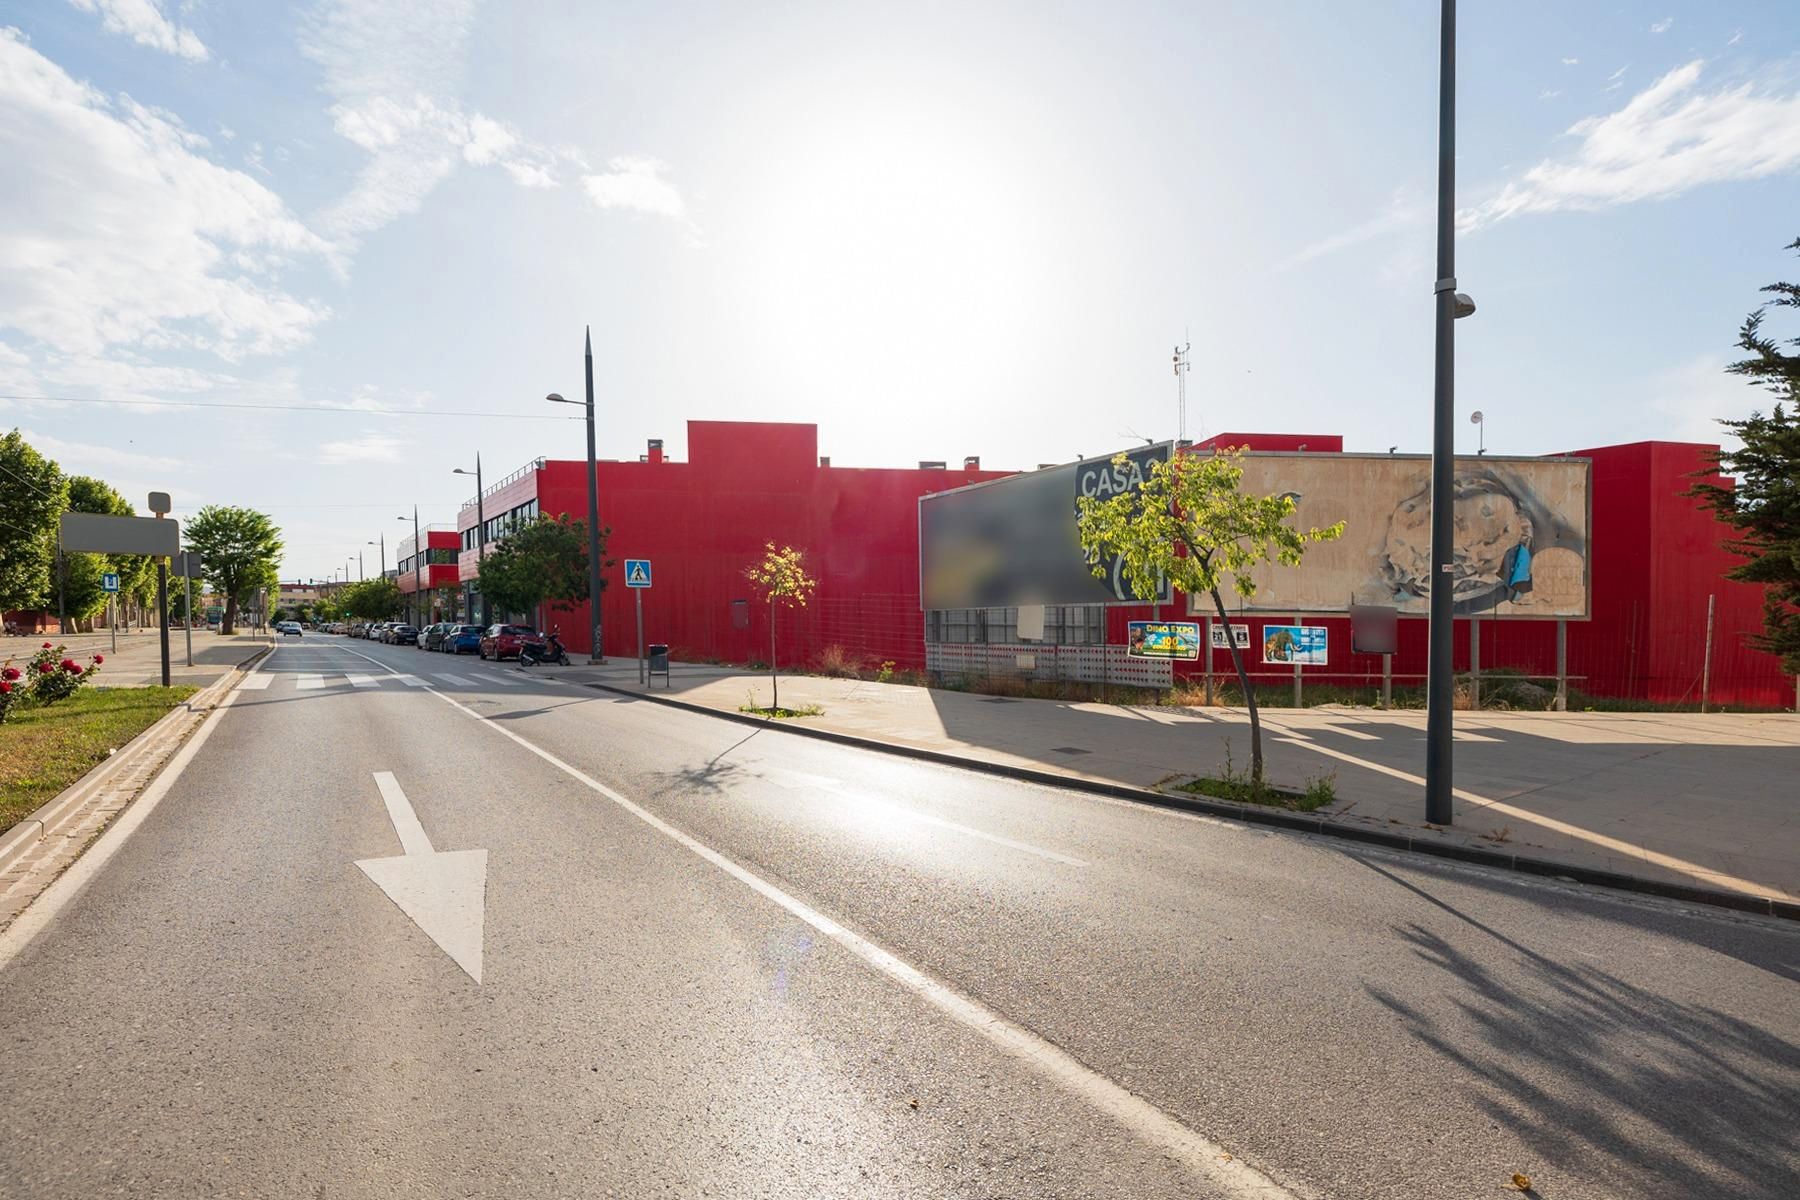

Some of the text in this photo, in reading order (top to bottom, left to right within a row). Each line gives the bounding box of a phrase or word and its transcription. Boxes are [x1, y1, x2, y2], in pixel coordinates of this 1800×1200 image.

[1082, 461, 1144, 498] CASA
[1146, 624, 1195, 634] DINO EXPO
